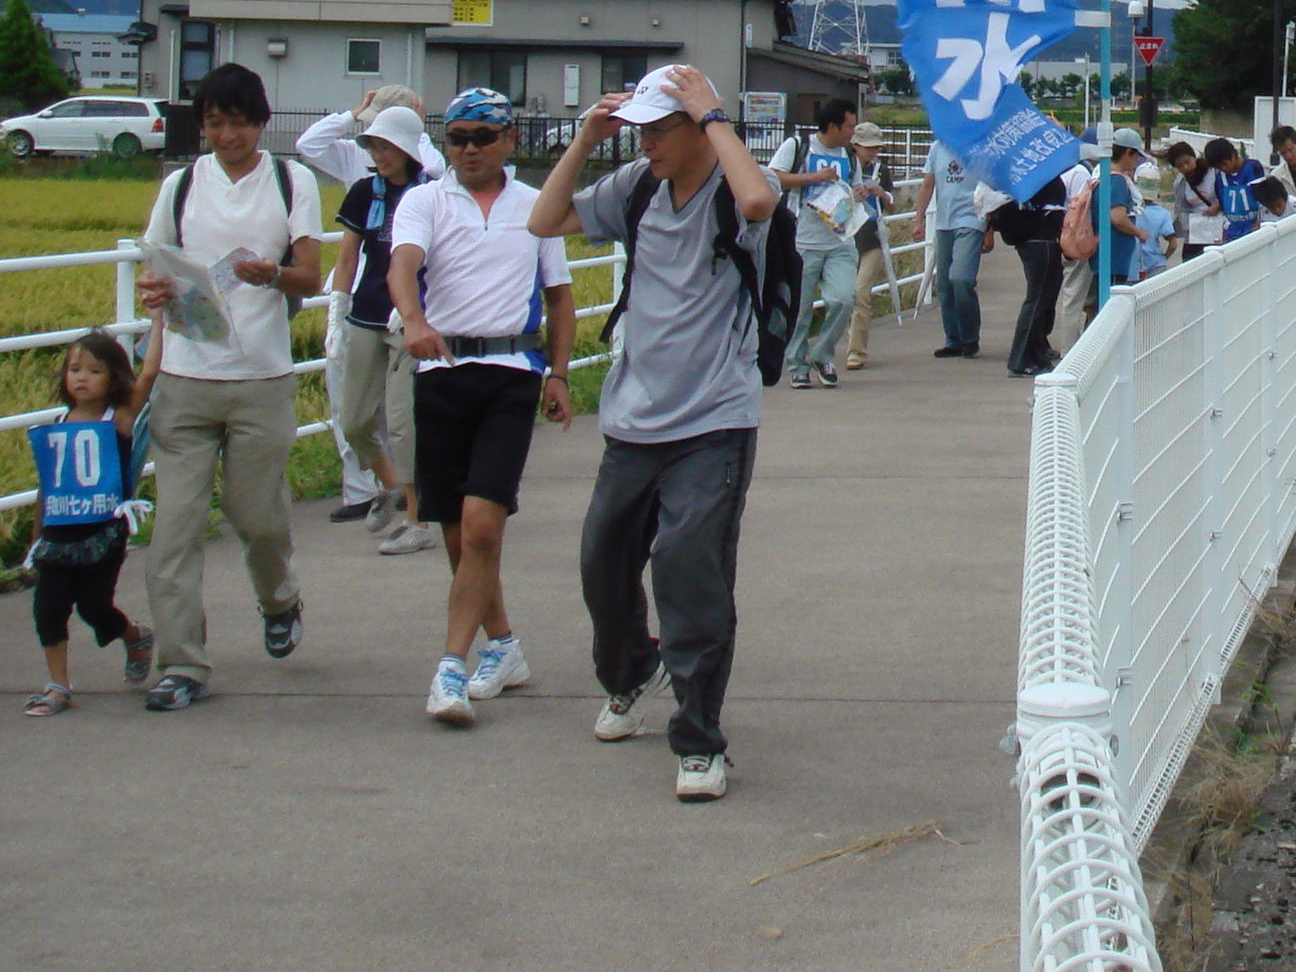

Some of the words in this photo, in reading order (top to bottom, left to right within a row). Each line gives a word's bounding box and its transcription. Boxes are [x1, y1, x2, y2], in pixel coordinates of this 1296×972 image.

[1138, 42, 1159, 50] 止まれ
[1228, 188, 1250, 213] 71
[47, 429, 101, 488] 70
